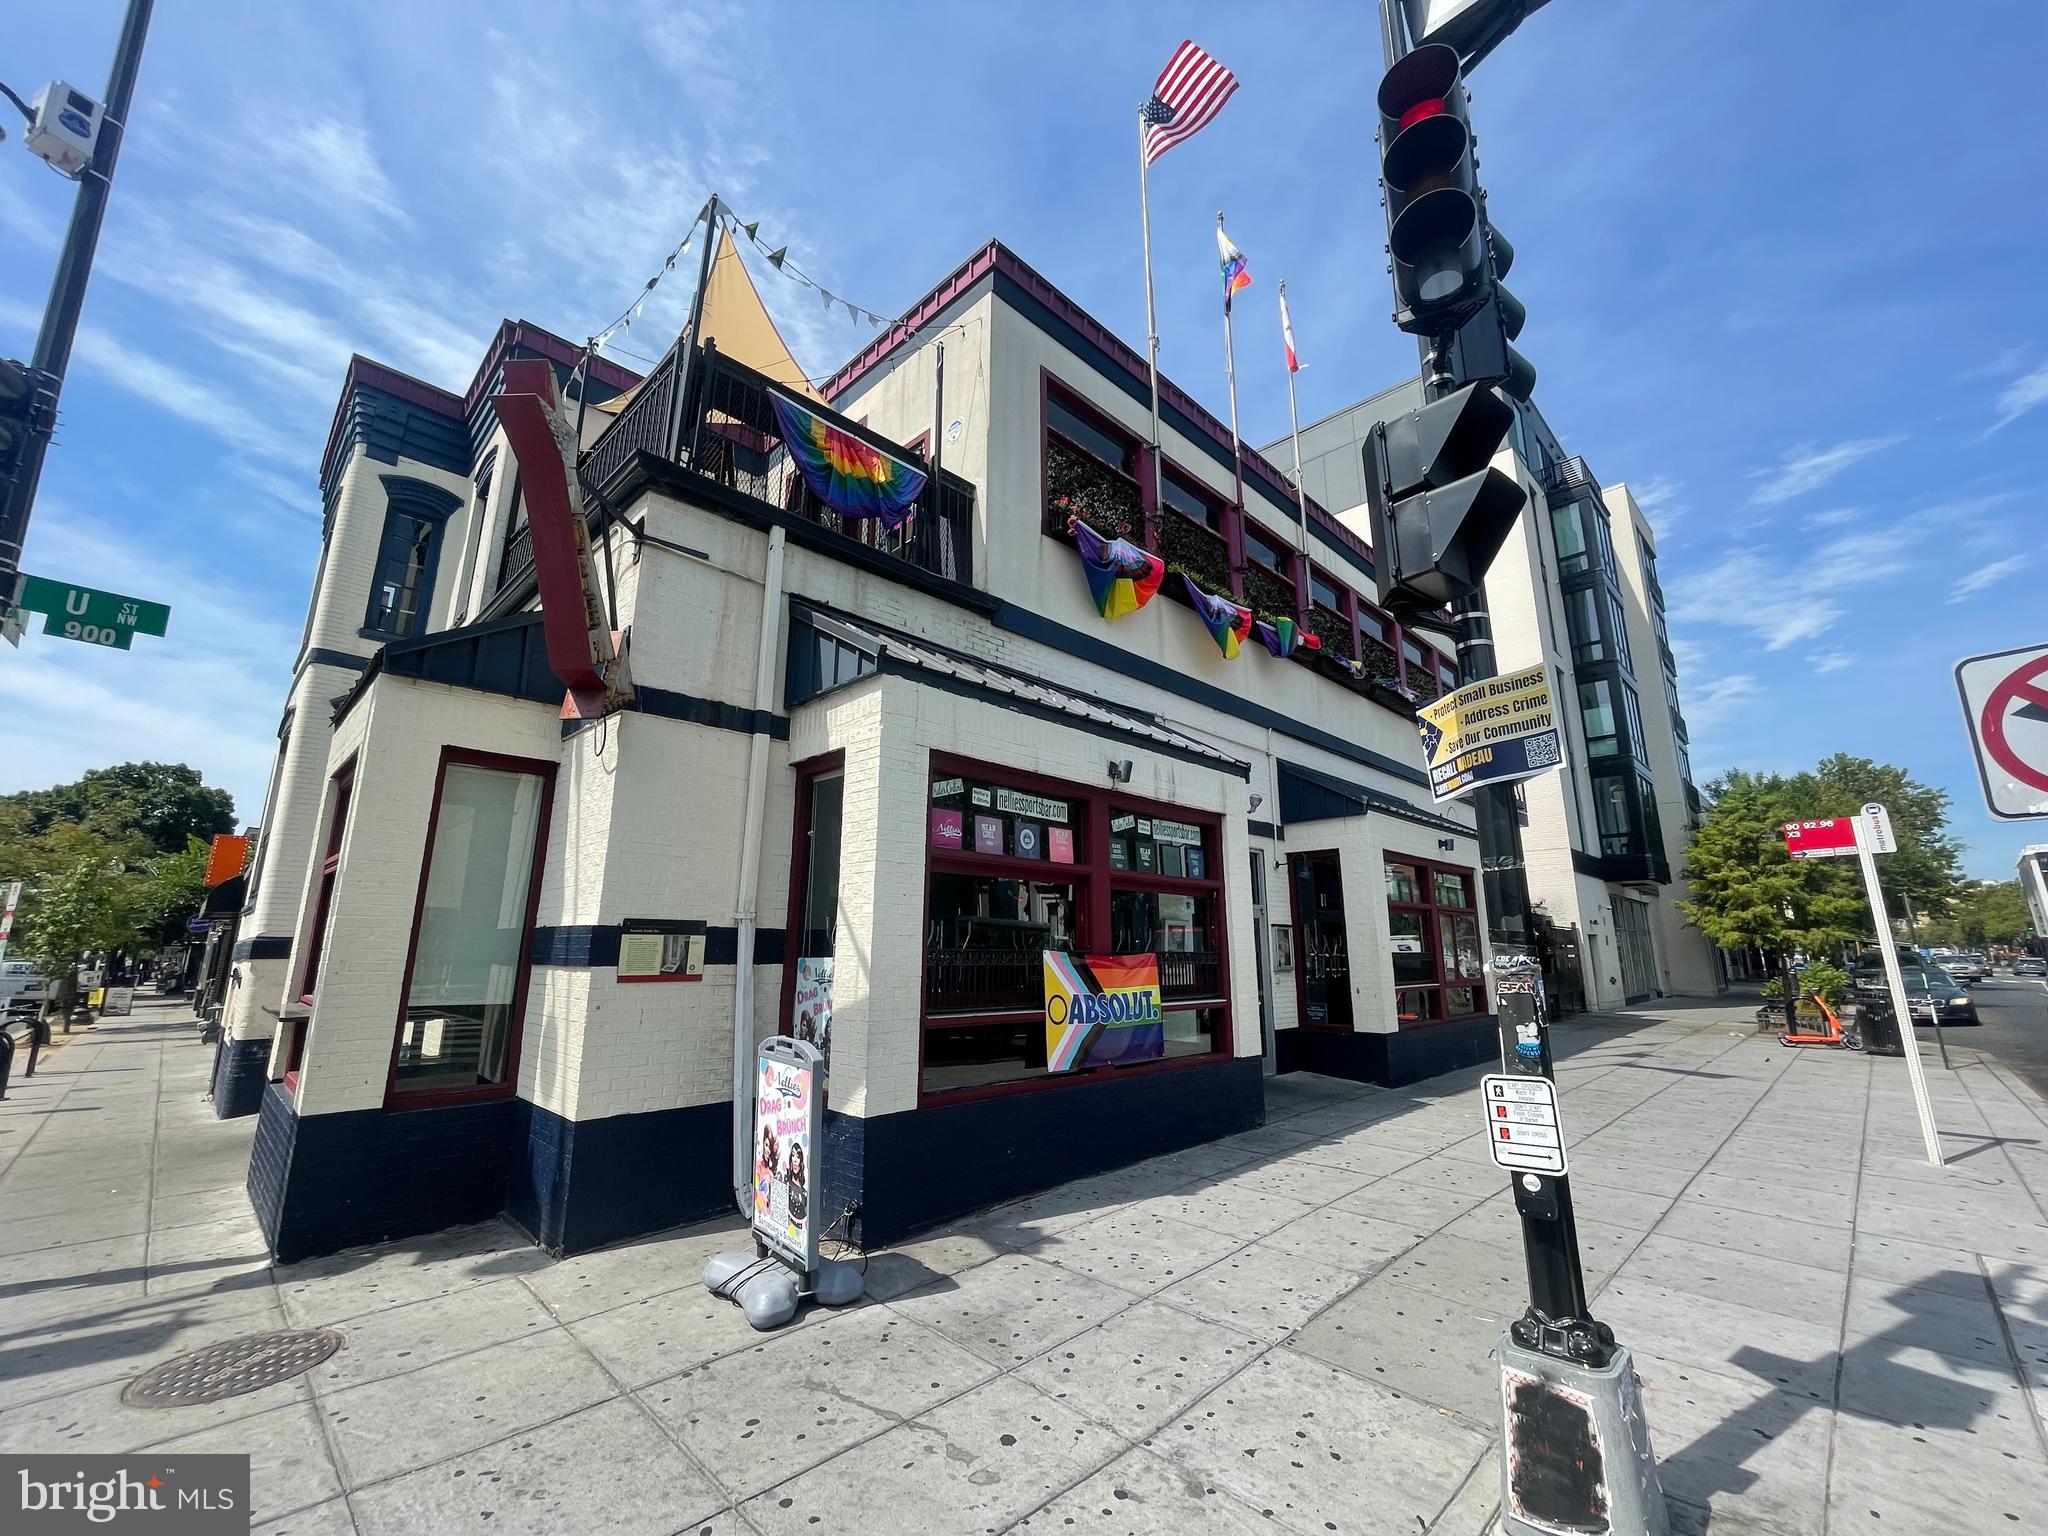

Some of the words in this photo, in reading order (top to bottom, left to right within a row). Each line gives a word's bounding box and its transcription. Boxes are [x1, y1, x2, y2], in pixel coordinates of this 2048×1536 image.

[65, 590, 90, 615] U
[121, 602, 140, 615] ST
[116, 612, 138, 627] NW
[64, 621, 117, 646] 900
[1433, 697, 1459, 720] Protect
[1458, 686, 1487, 707] Small
[1489, 671, 1544, 697] Business
[1464, 703, 1510, 726] Address
[1512, 693, 1548, 713] Crime
[1448, 738, 1464, 754] Save
[1465, 731, 1481, 746] Our
[1483, 713, 1551, 740] Community
[1432, 761, 1458, 784] RECALL
[999, 791, 1067, 820] nelliessportsbar.com
[1785, 823, 1800, 831] 90
[1803, 821, 1816, 829] 92
[1820, 819, 1834, 828] 96
[1871, 815, 1887, 852] metrobus
[797, 986, 818, 1005] DRAG
[813, 1001, 832, 1015] BRUN
[1068, 990, 1160, 1025] ABSOLUT.
[760, 1098, 781, 1116] DRAG
[776, 1116, 806, 1136] BRUNCH
